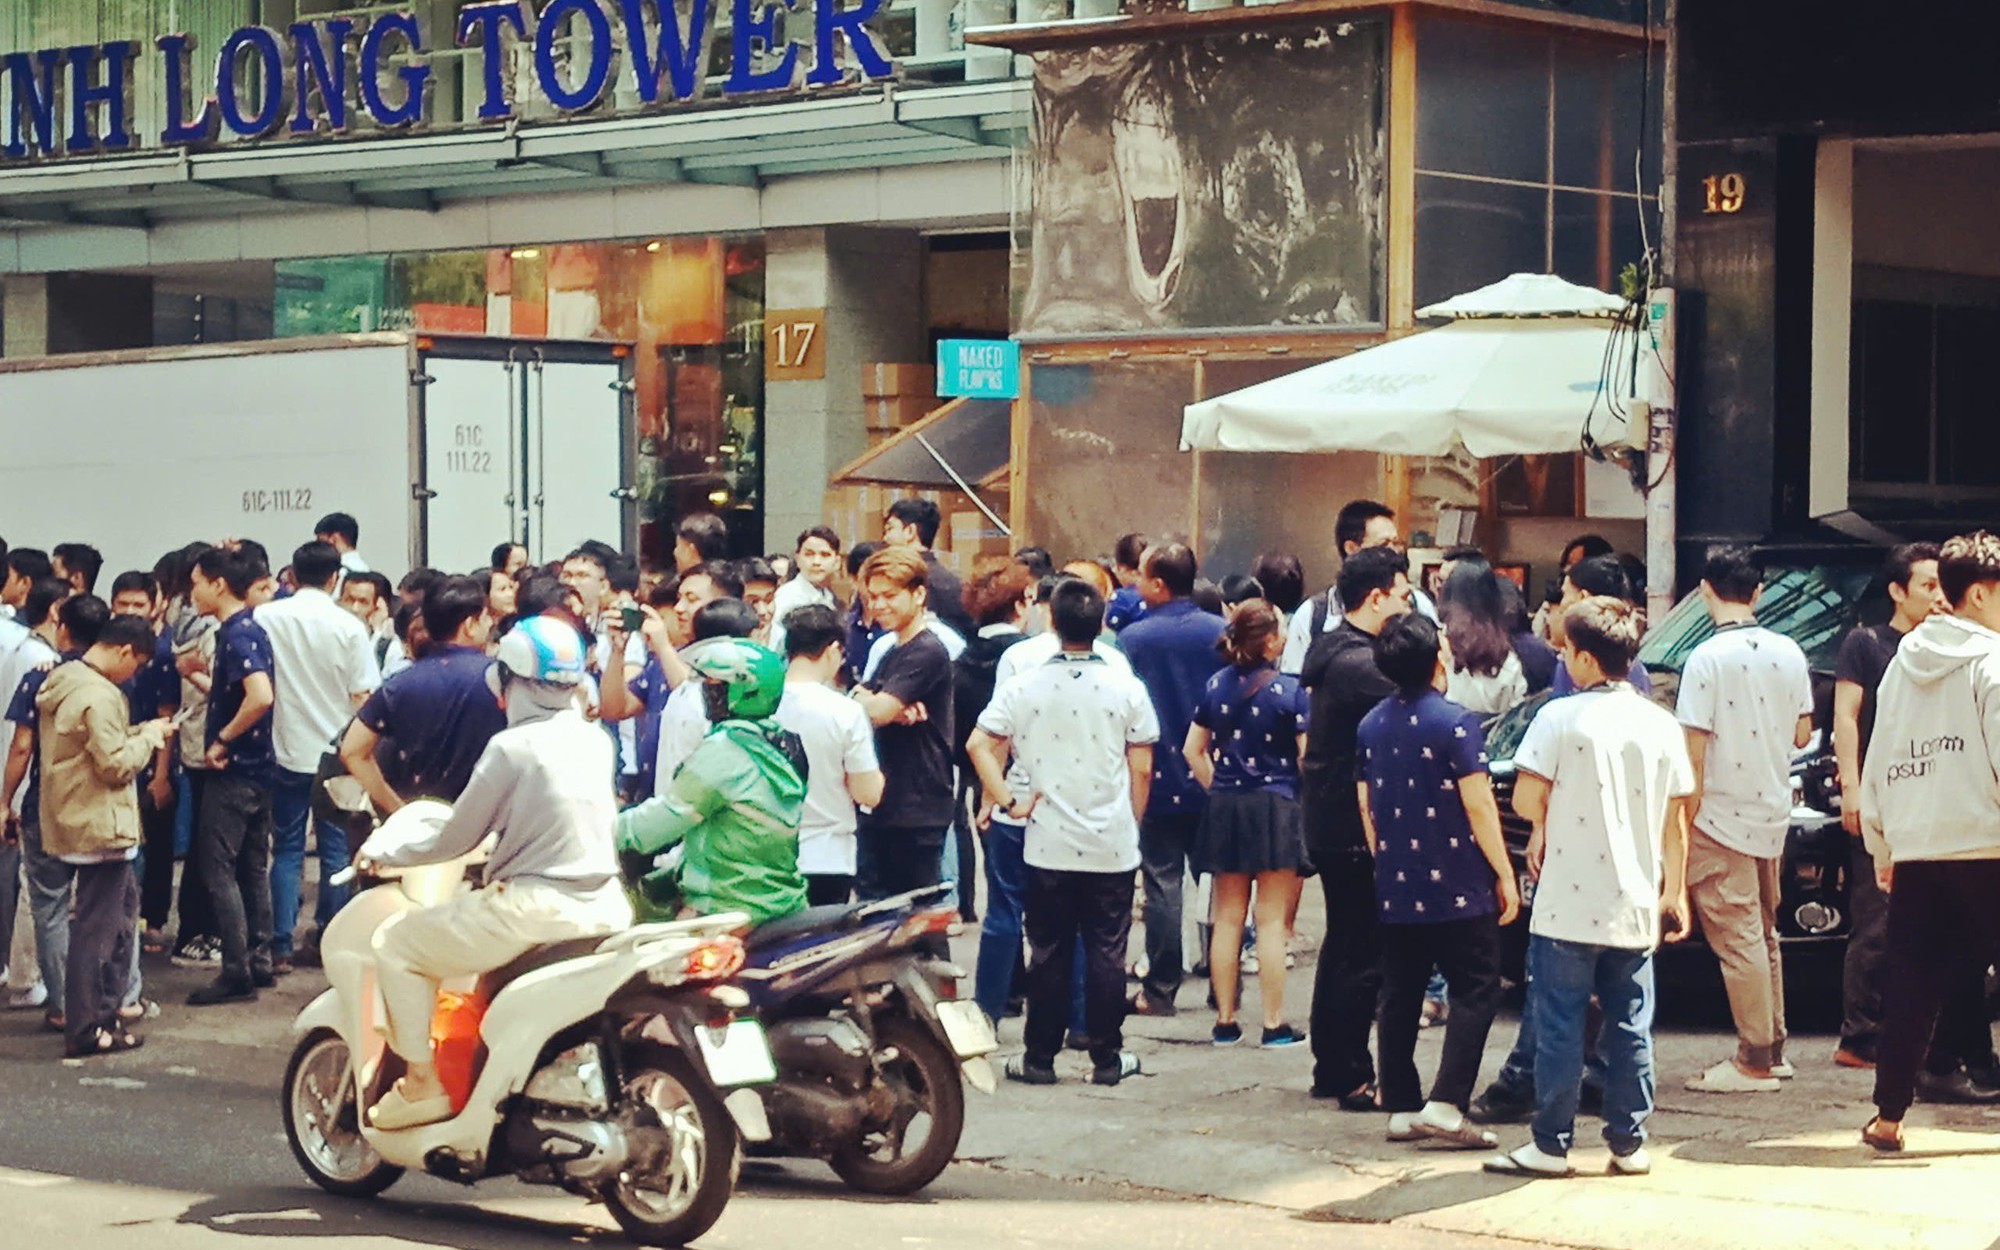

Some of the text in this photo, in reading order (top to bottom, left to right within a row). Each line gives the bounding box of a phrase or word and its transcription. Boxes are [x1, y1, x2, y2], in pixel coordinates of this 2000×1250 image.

[154, 12, 431, 142] LONG
[456, 0, 894, 118] TOWER
[1701, 173, 1745, 213] 19
[771, 322, 816, 368] 17
[958, 346, 1003, 368] NAKED
[455, 425, 482, 446] 61C
[446, 451, 492, 473] 111.22
[242, 488, 312, 512] 61C-111.22
